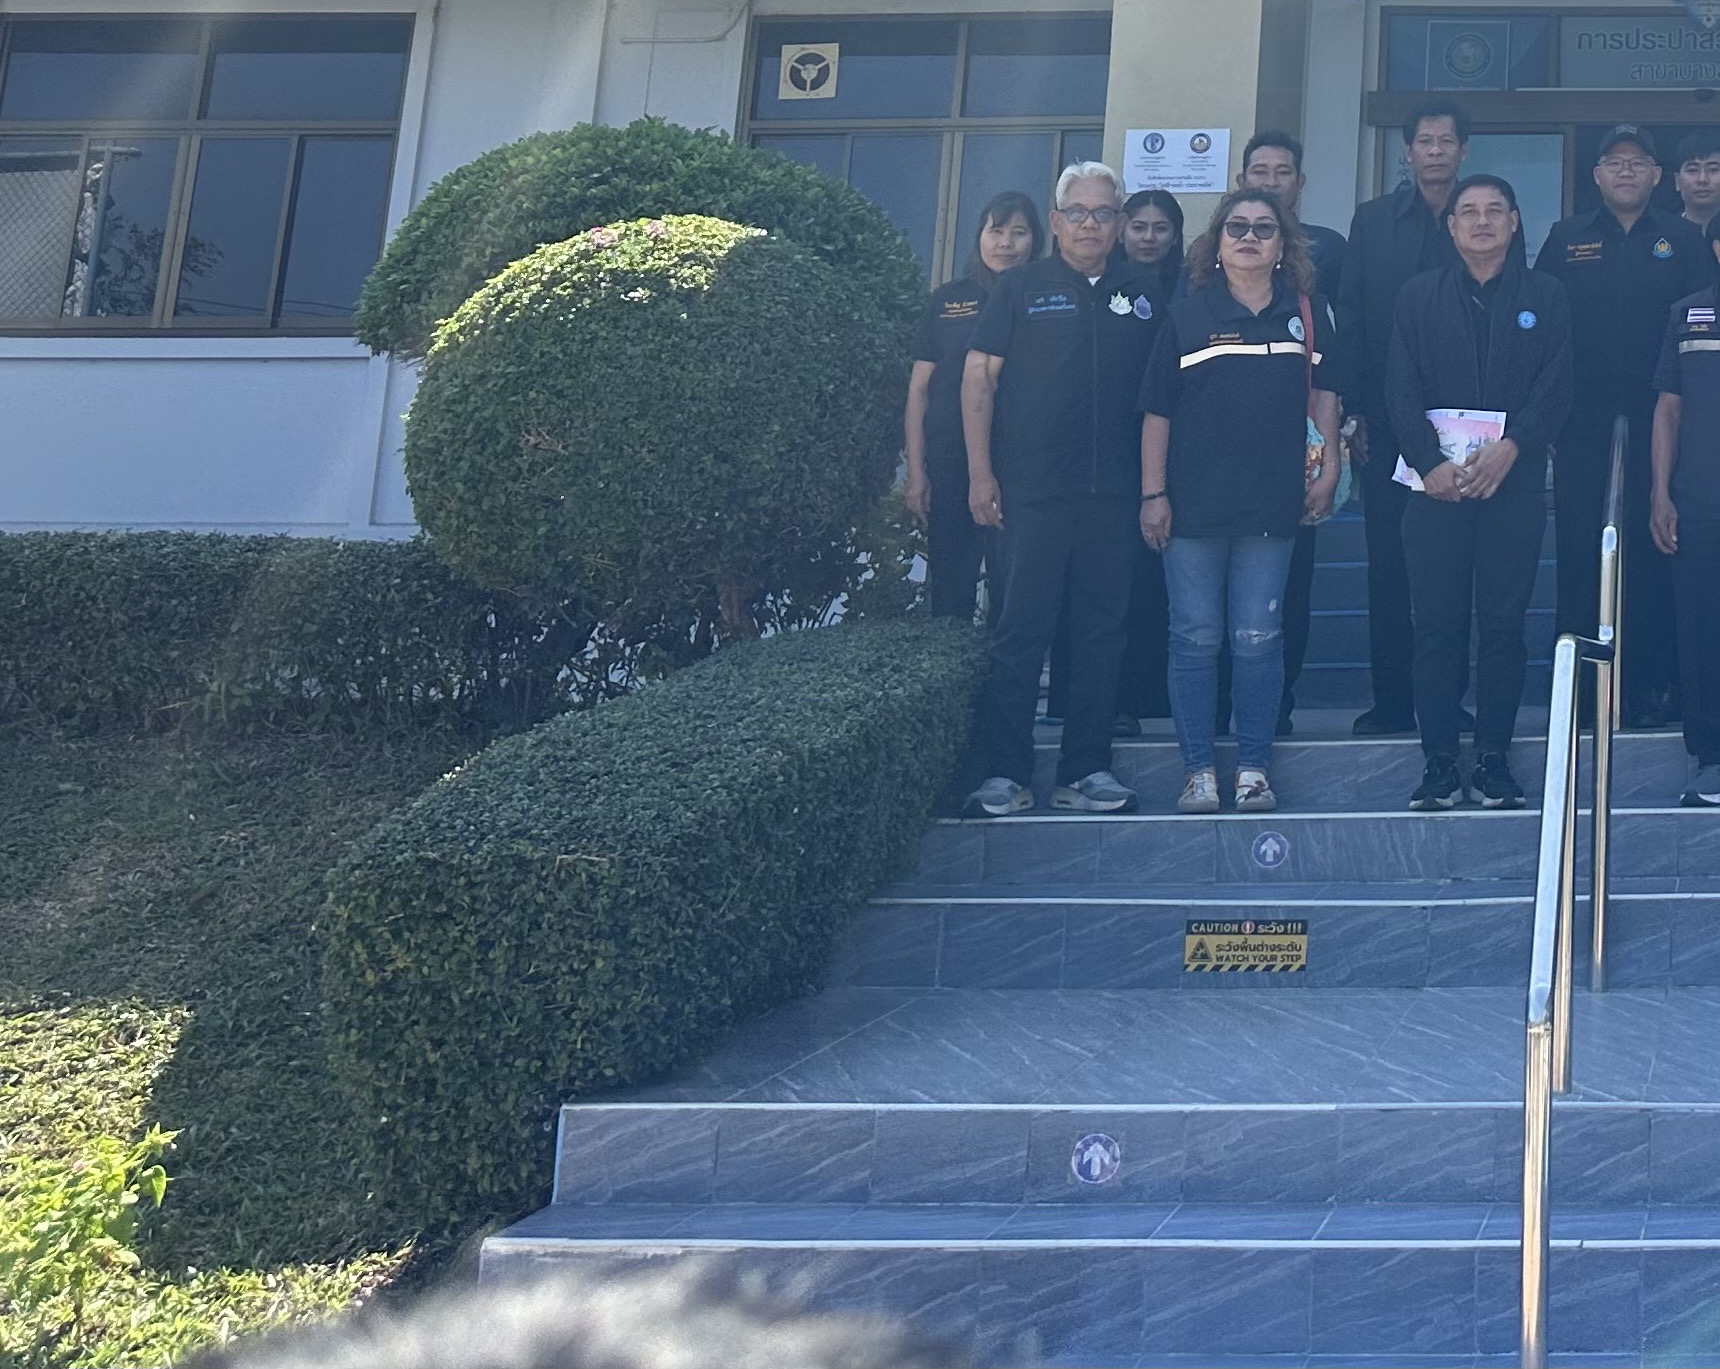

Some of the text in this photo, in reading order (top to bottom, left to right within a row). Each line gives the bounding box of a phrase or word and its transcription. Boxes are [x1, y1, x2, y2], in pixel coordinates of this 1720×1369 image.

[1192, 922, 1238, 933] CAUTION
[1257, 922, 1284, 933] ระวัง
[1216, 937, 1302, 952] ระวังพื้นต่างระดับ
[1216, 954, 1302, 962] WATCH YOUR STEP
